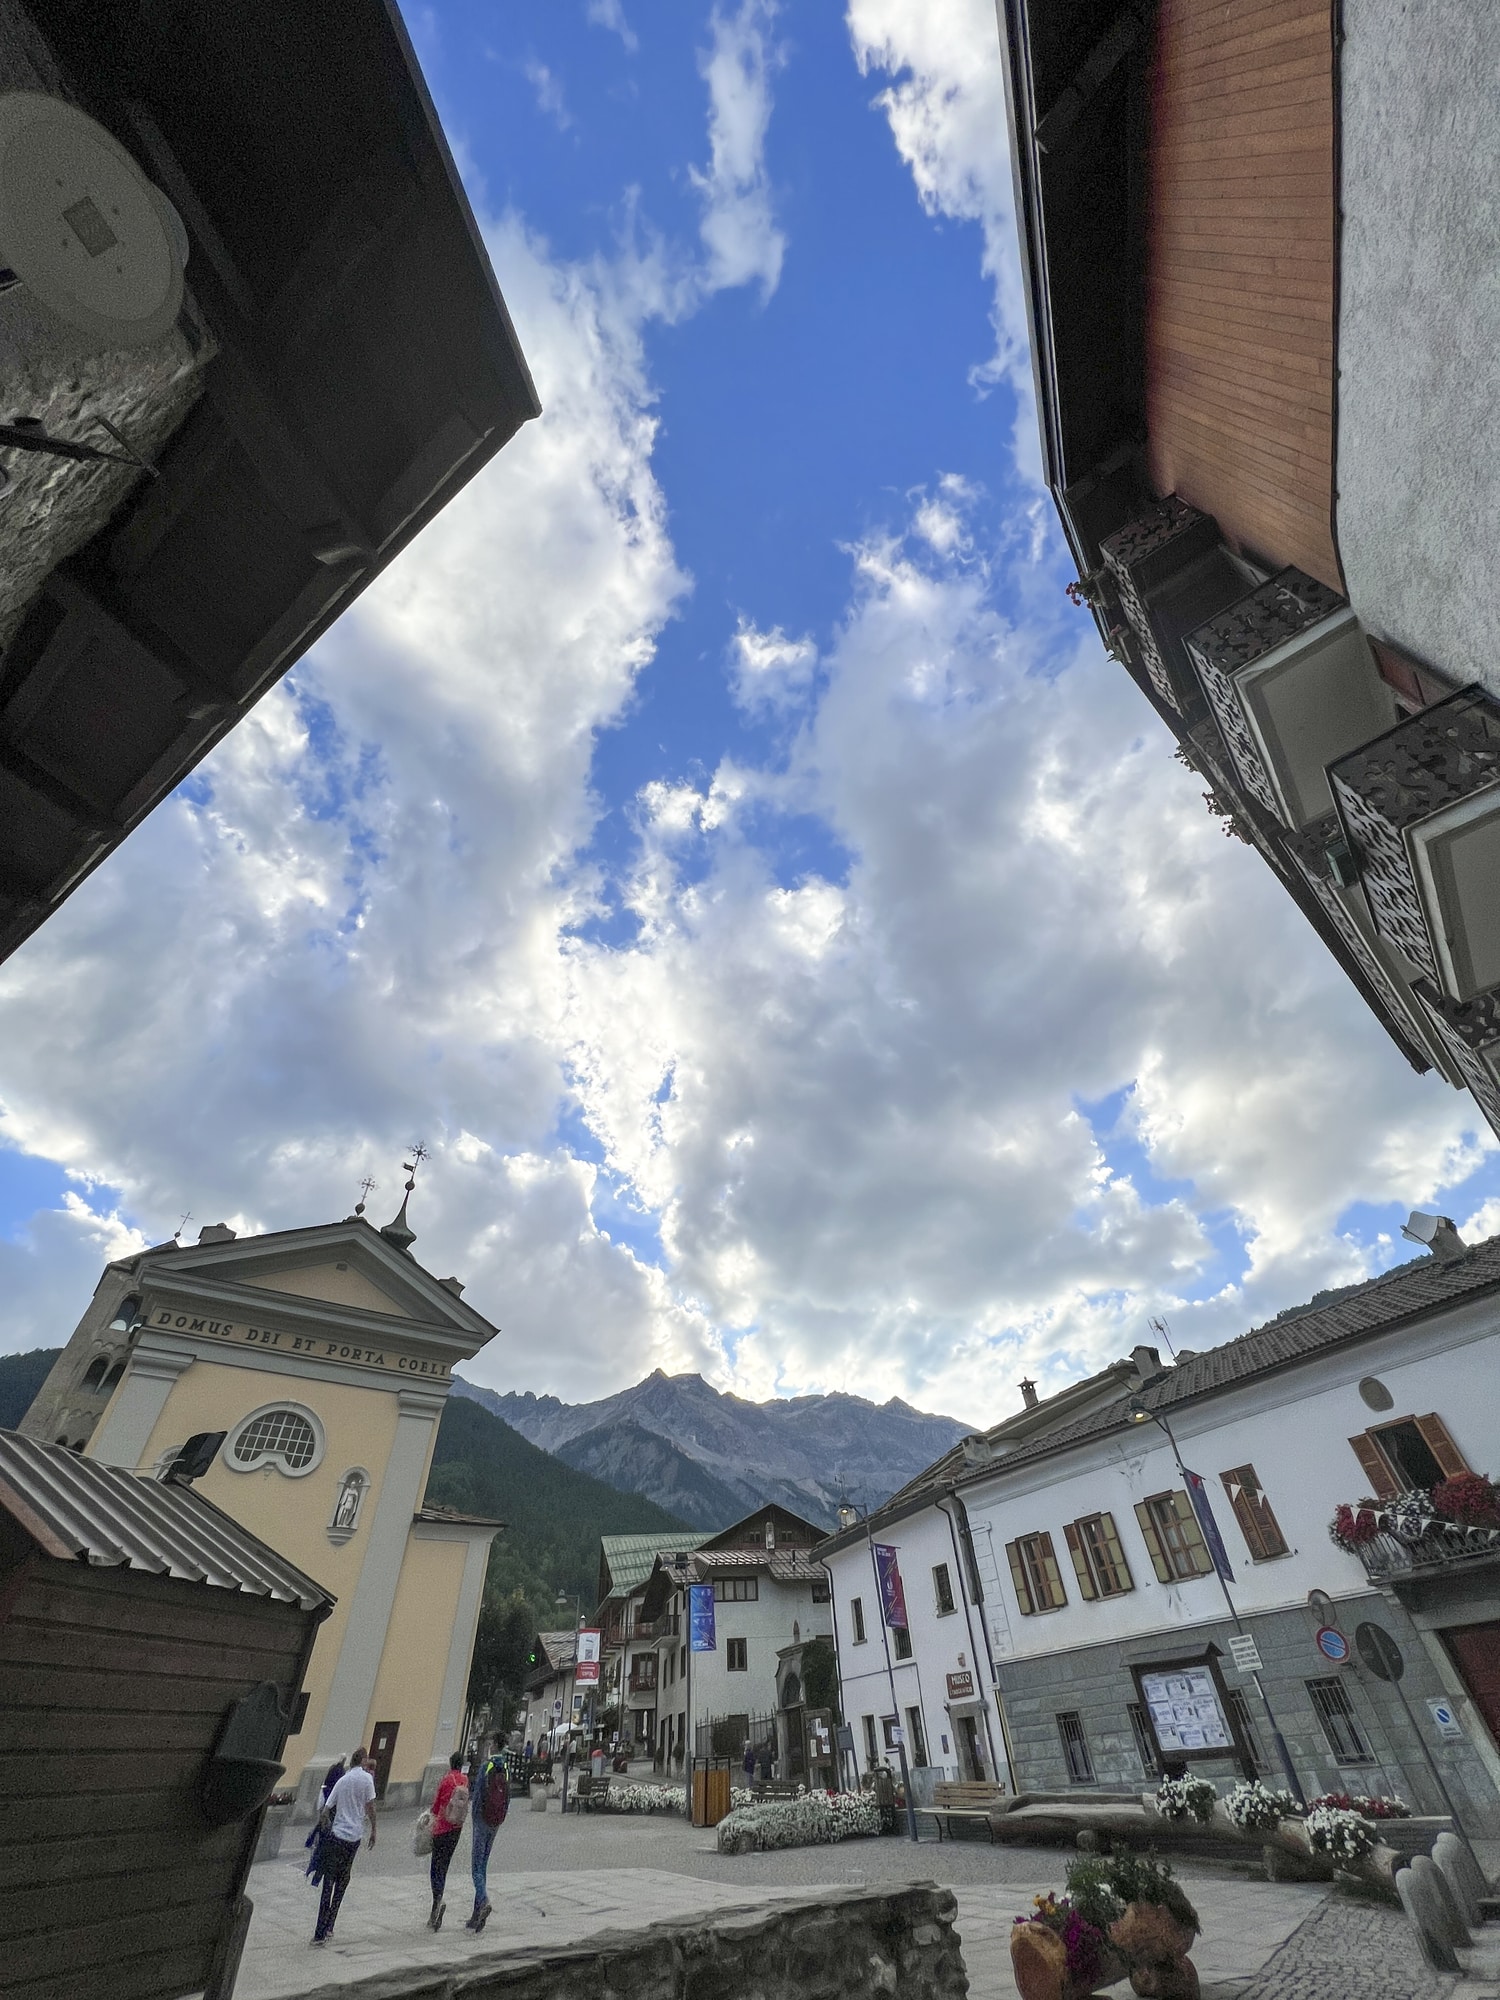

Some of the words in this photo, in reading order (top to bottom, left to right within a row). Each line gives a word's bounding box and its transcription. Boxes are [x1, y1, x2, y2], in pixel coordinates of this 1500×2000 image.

[158, 1312, 234, 1336] DOMUS
[245, 1328, 281, 1345] DEI
[292, 1337, 316, 1351] ET
[326, 1343, 385, 1365] PORTA
[398, 1357, 447, 1376] COELI
[951, 1673, 970, 1686] MUSEO
